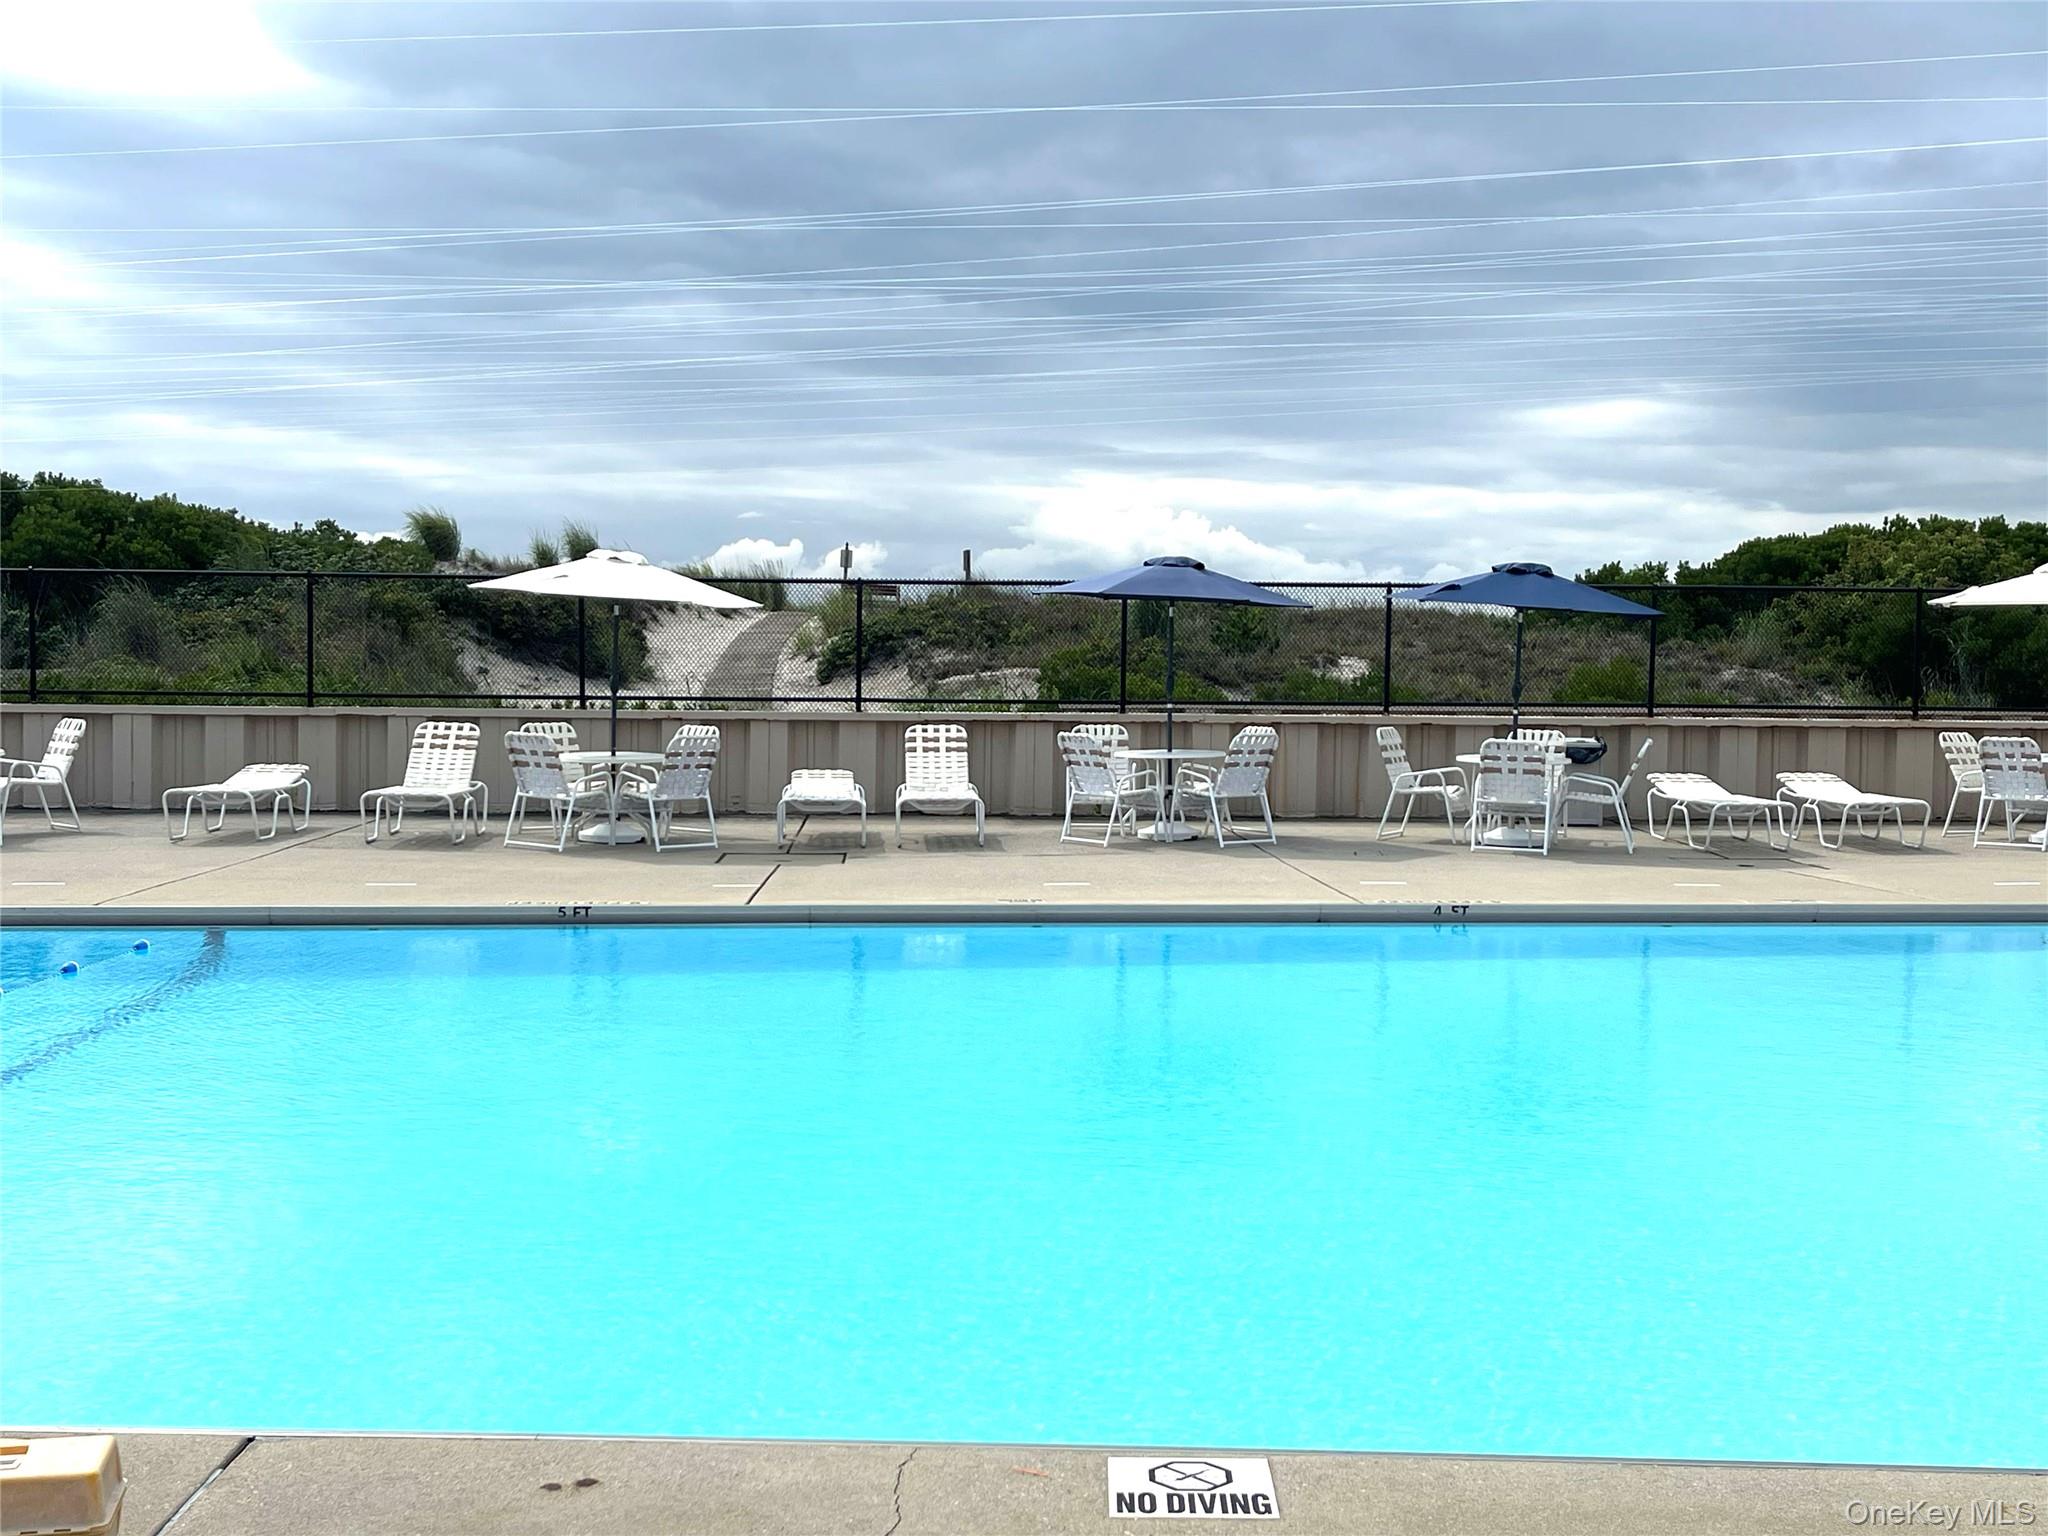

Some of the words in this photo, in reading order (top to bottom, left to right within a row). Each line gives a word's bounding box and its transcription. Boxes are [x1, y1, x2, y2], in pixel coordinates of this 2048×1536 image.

[558, 906, 567, 918] 5
[573, 906, 592, 918] FT
[1116, 1492, 1157, 1513] NO
[1166, 1493, 1273, 1515] DIVING
